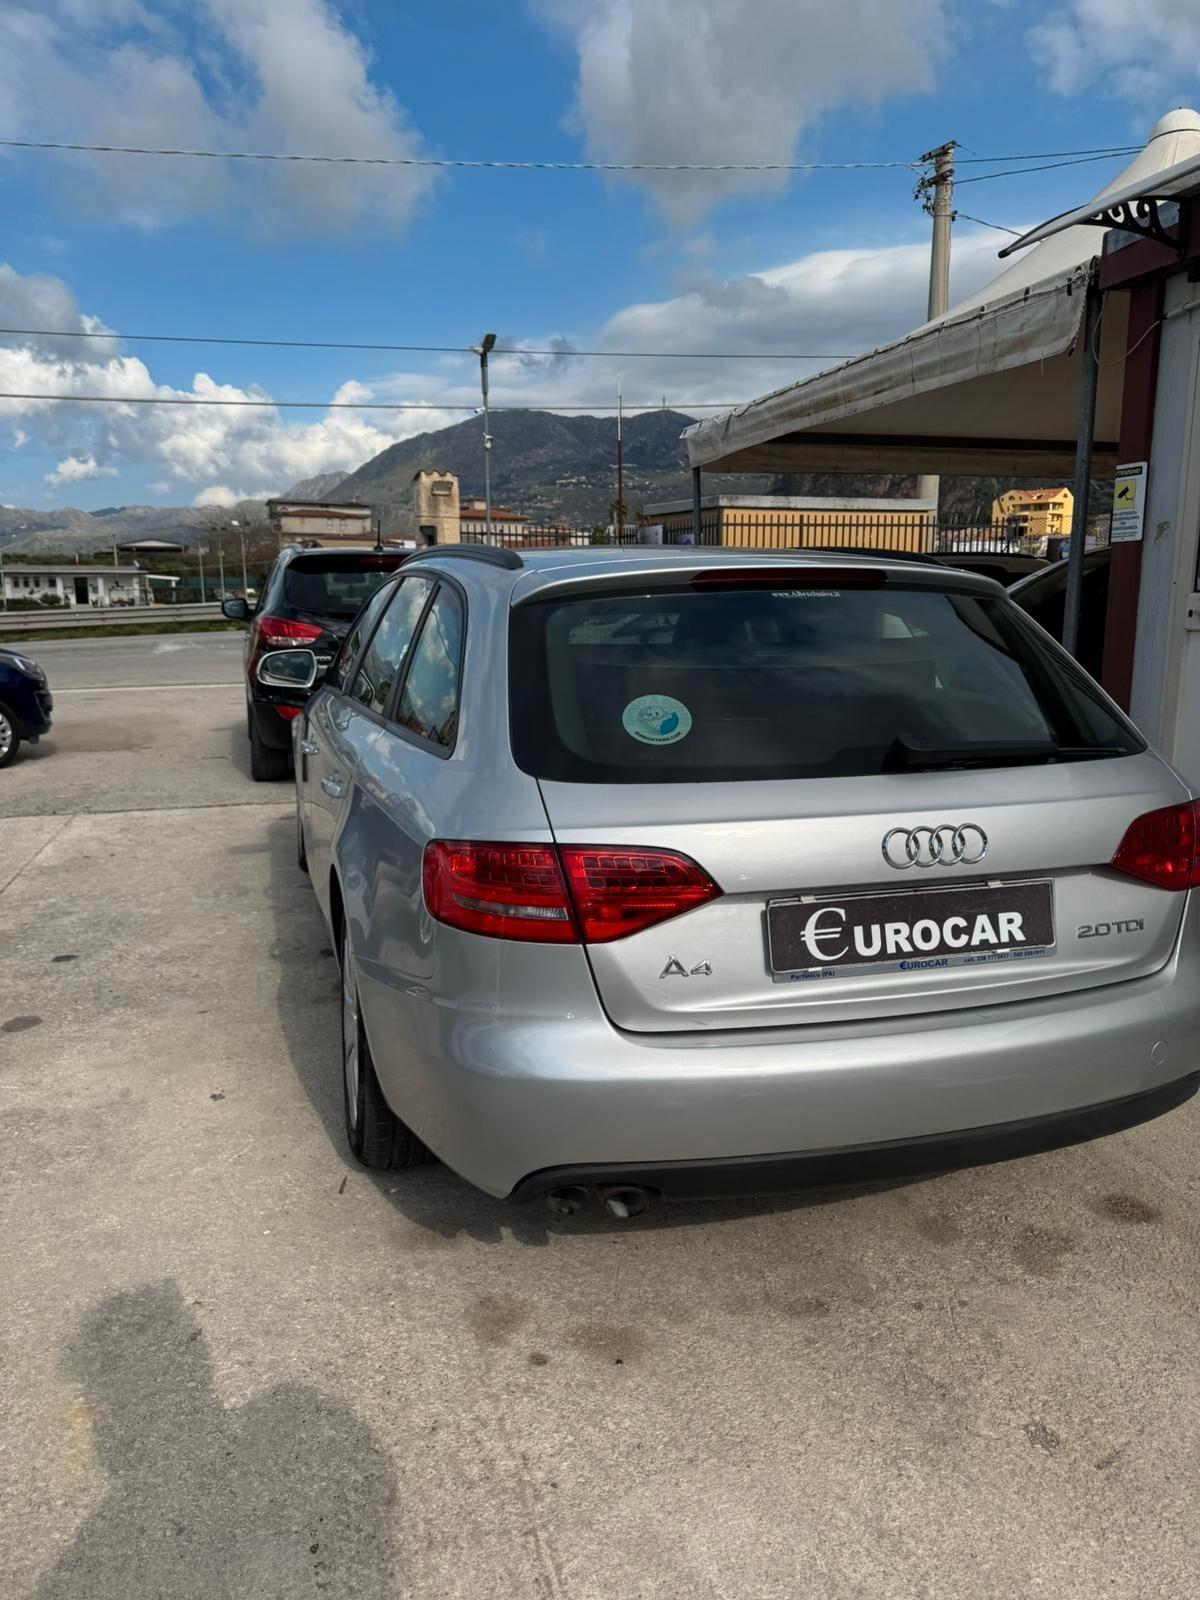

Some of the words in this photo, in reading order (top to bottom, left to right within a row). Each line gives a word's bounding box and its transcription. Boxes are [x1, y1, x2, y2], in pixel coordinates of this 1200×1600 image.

[800, 907, 1026, 961] €UROCAR
[659, 955, 712, 979] A4
[900, 959, 948, 970] €UROCAR
